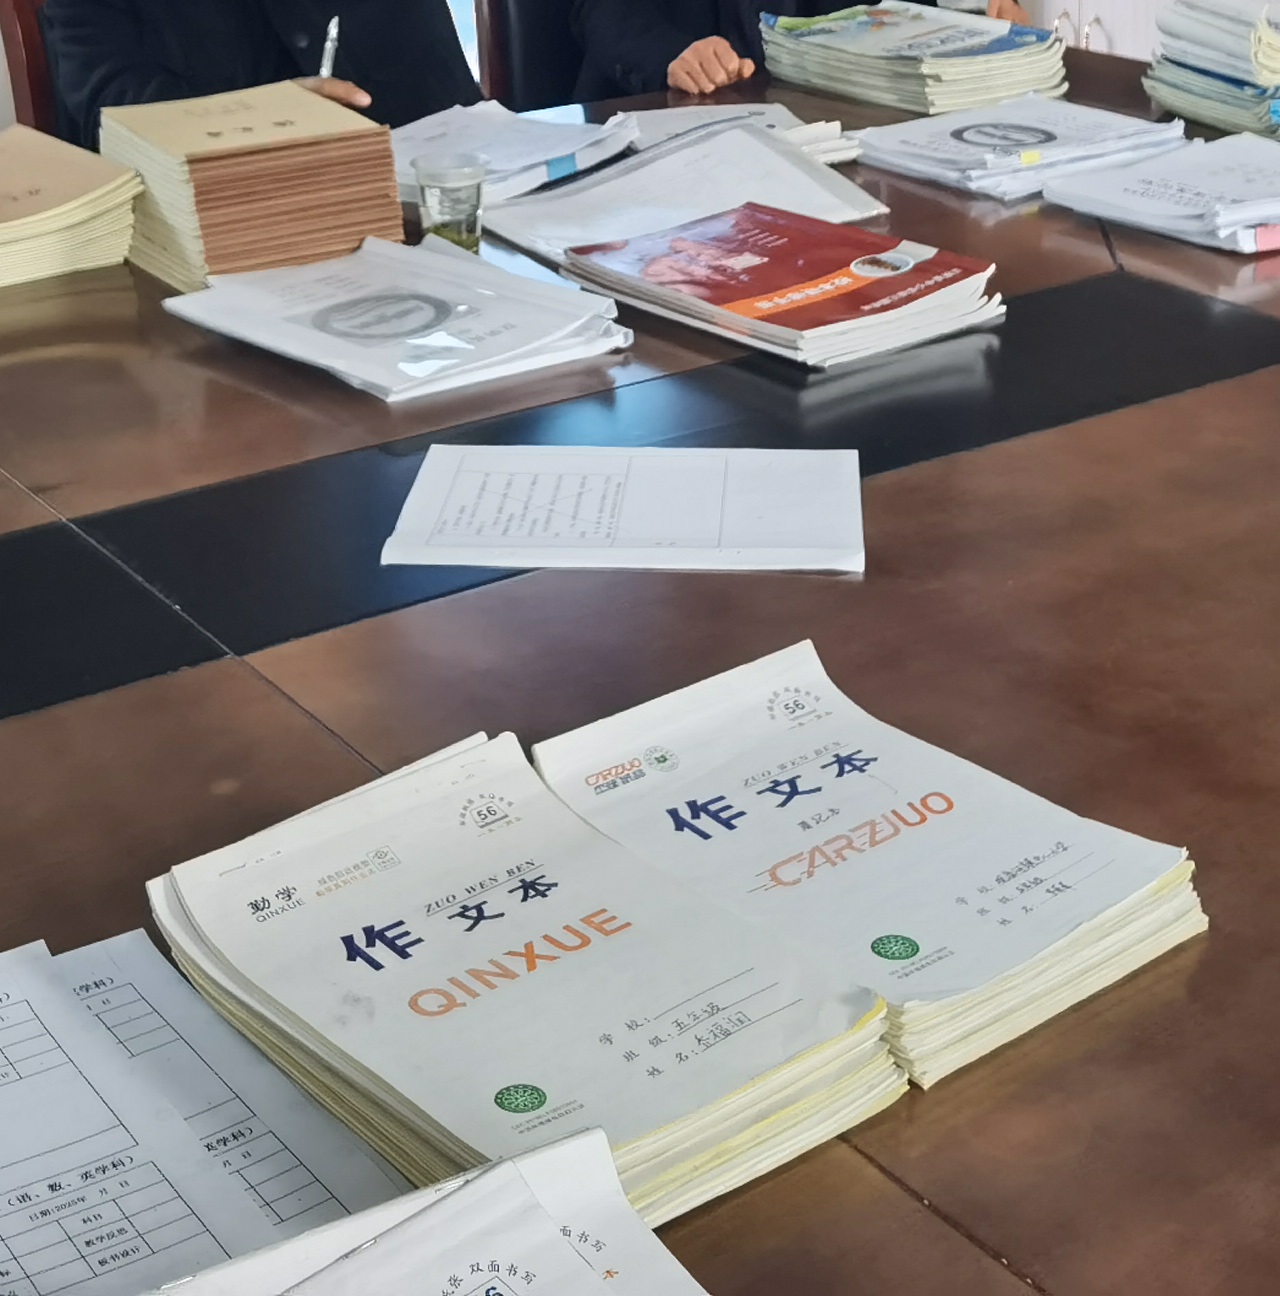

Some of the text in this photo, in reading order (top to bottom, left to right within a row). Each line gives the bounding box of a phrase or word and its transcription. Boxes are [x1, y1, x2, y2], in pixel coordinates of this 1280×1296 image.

[783, 699, 806, 715] 56
[476, 805, 498, 821] 56
[666, 749, 879, 841] 作文本
[758, 791, 955, 888] CARZUO
[255, 897, 307, 924] QINXUE
[424, 893, 458, 915] ZUO
[464, 874, 499, 896] WEN
[340, 874, 559, 972] 作文本
[407, 907, 633, 1017] QINXUE
[469, 1259, 537, 1286] 双面书写
